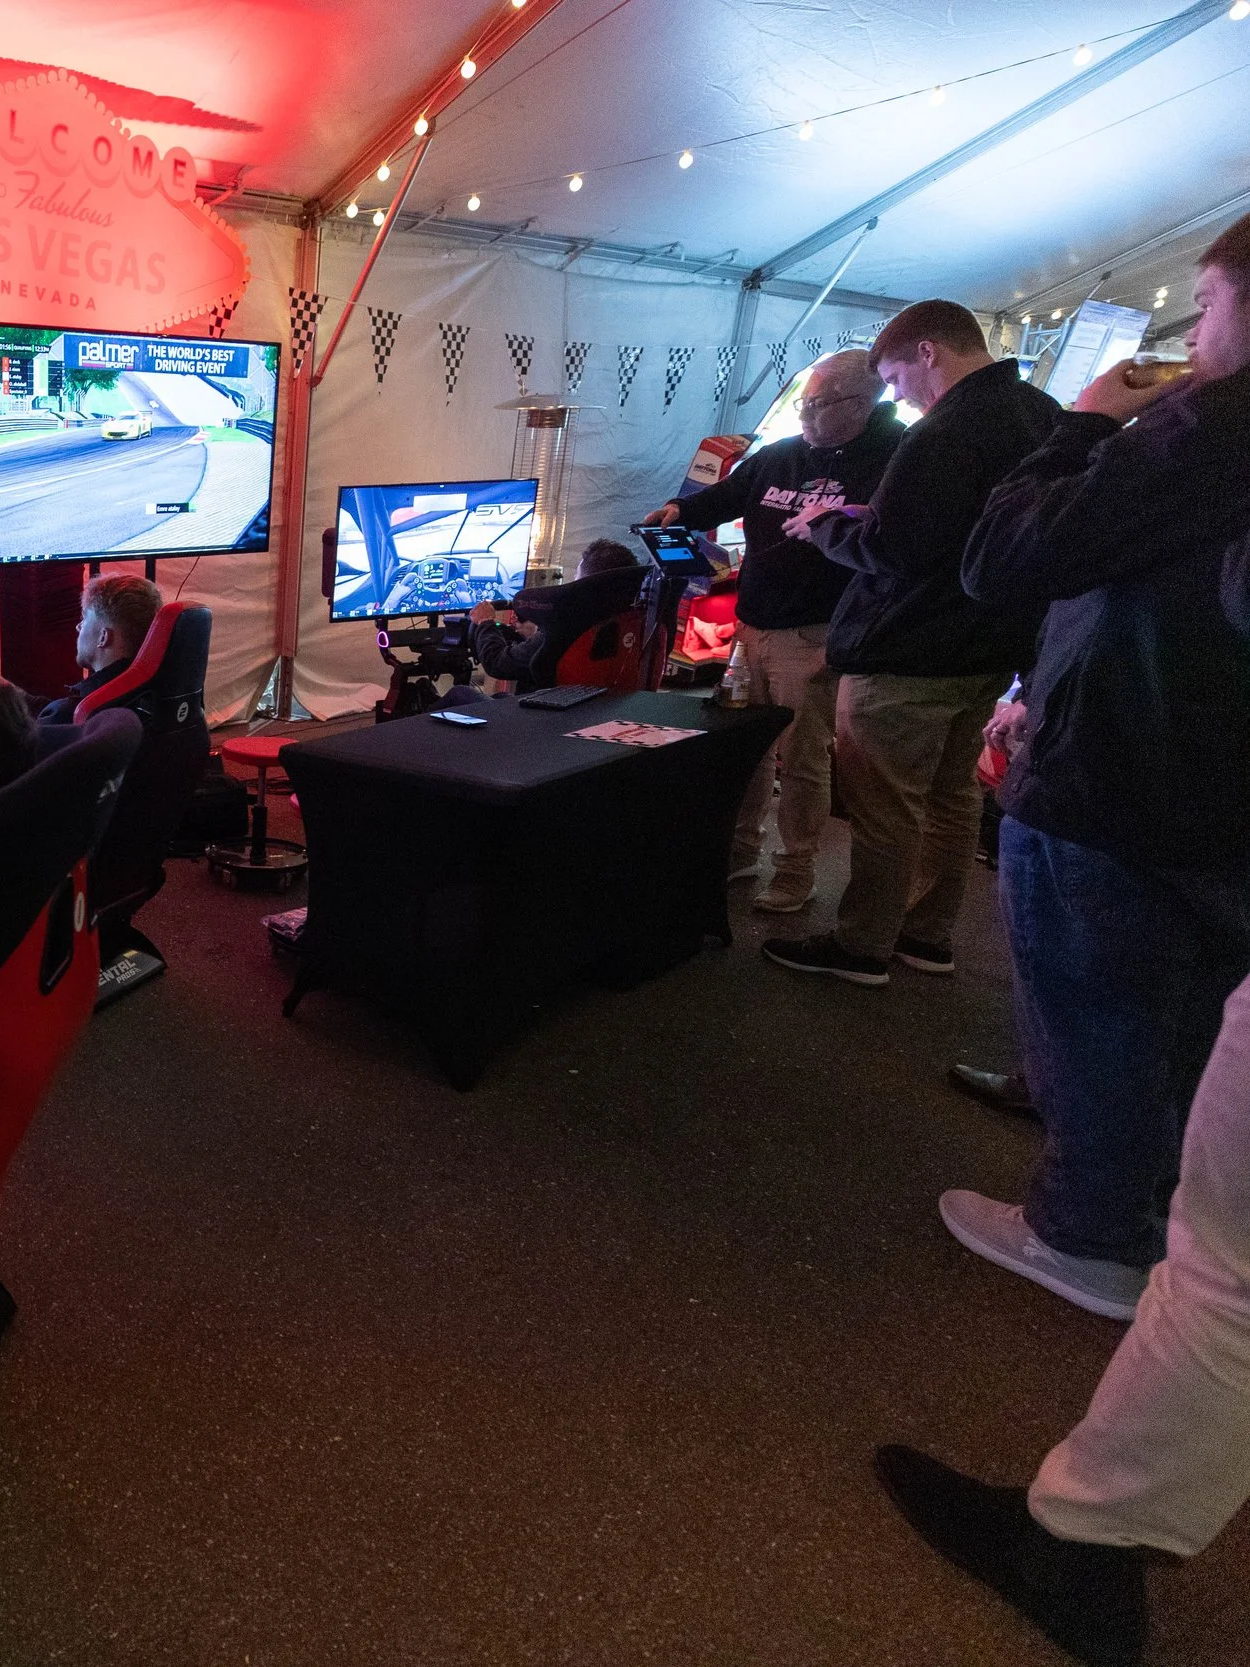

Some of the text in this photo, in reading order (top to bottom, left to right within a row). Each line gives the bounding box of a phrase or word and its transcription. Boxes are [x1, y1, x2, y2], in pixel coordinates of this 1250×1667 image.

[14, 170, 115, 227] Fabulous
[25, 223, 167, 294] VEGAS
[0, 279, 96, 311] NEVADA
[78, 340, 235, 366] palmer THE WORLD'S BEST
[105, 361, 126, 369] SPORT
[155, 359, 226, 375] DRIVING EVENT
[116, 967, 136, 983] PROS
